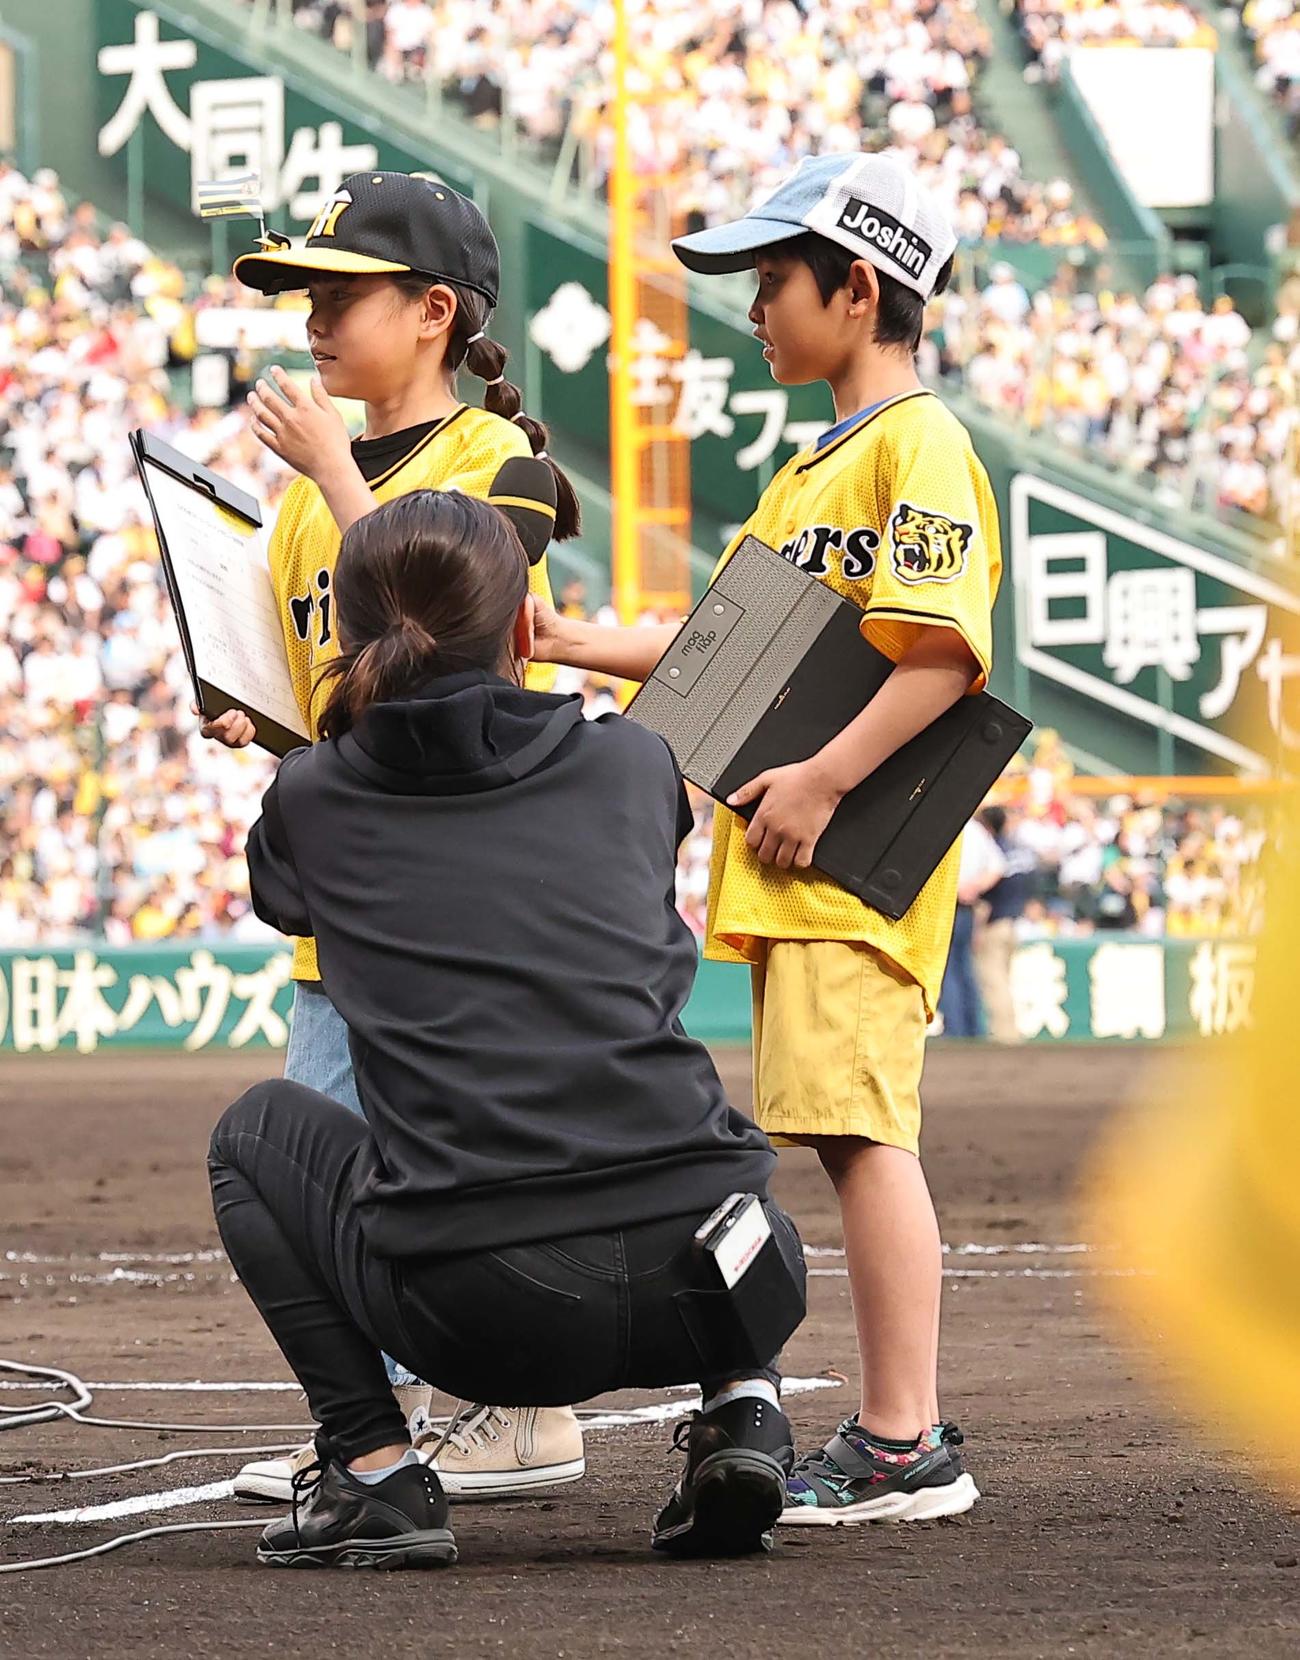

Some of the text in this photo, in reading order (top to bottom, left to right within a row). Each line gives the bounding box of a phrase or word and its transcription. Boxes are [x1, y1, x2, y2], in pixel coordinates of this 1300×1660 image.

[842, 203, 926, 275] Joshin
[681, 630, 705, 657] mag
[695, 630, 717, 654] flap
[11, 948, 295, 1053] 日本ハウズ
